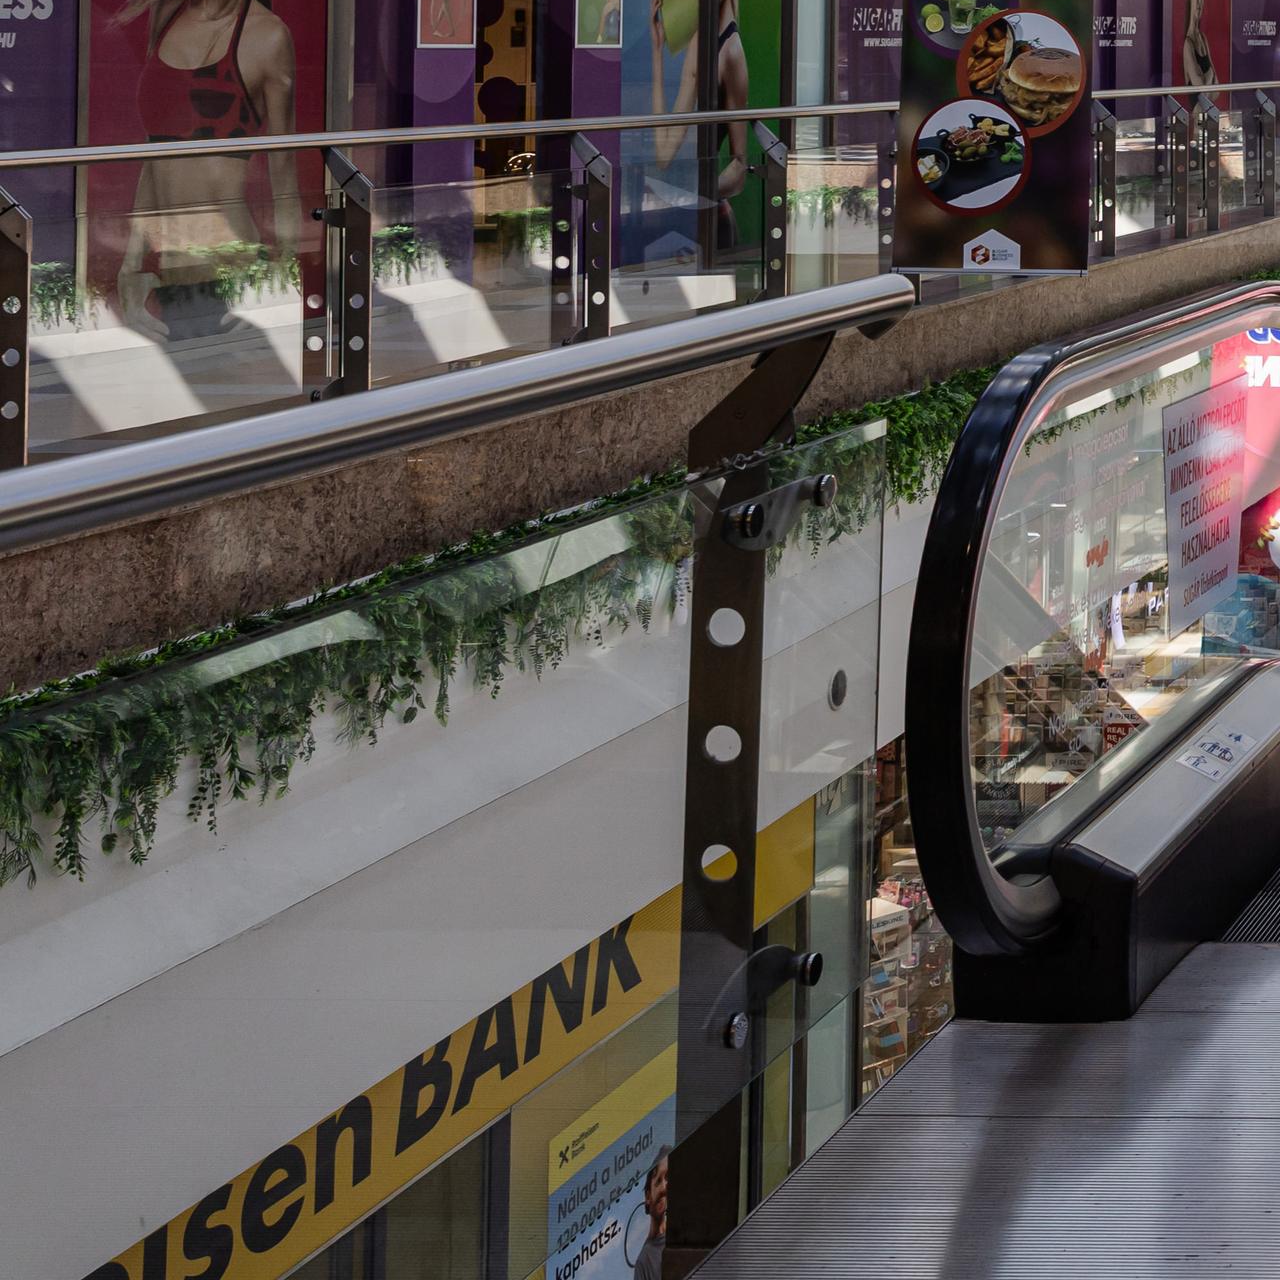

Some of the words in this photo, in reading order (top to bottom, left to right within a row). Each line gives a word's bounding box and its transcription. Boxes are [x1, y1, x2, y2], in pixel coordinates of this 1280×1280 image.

[395, 915, 641, 1158] BANK
[557, 1171, 597, 1224] Nálad
[602, 1166, 610, 1185] a
[614, 1126, 653, 1176] labda!
